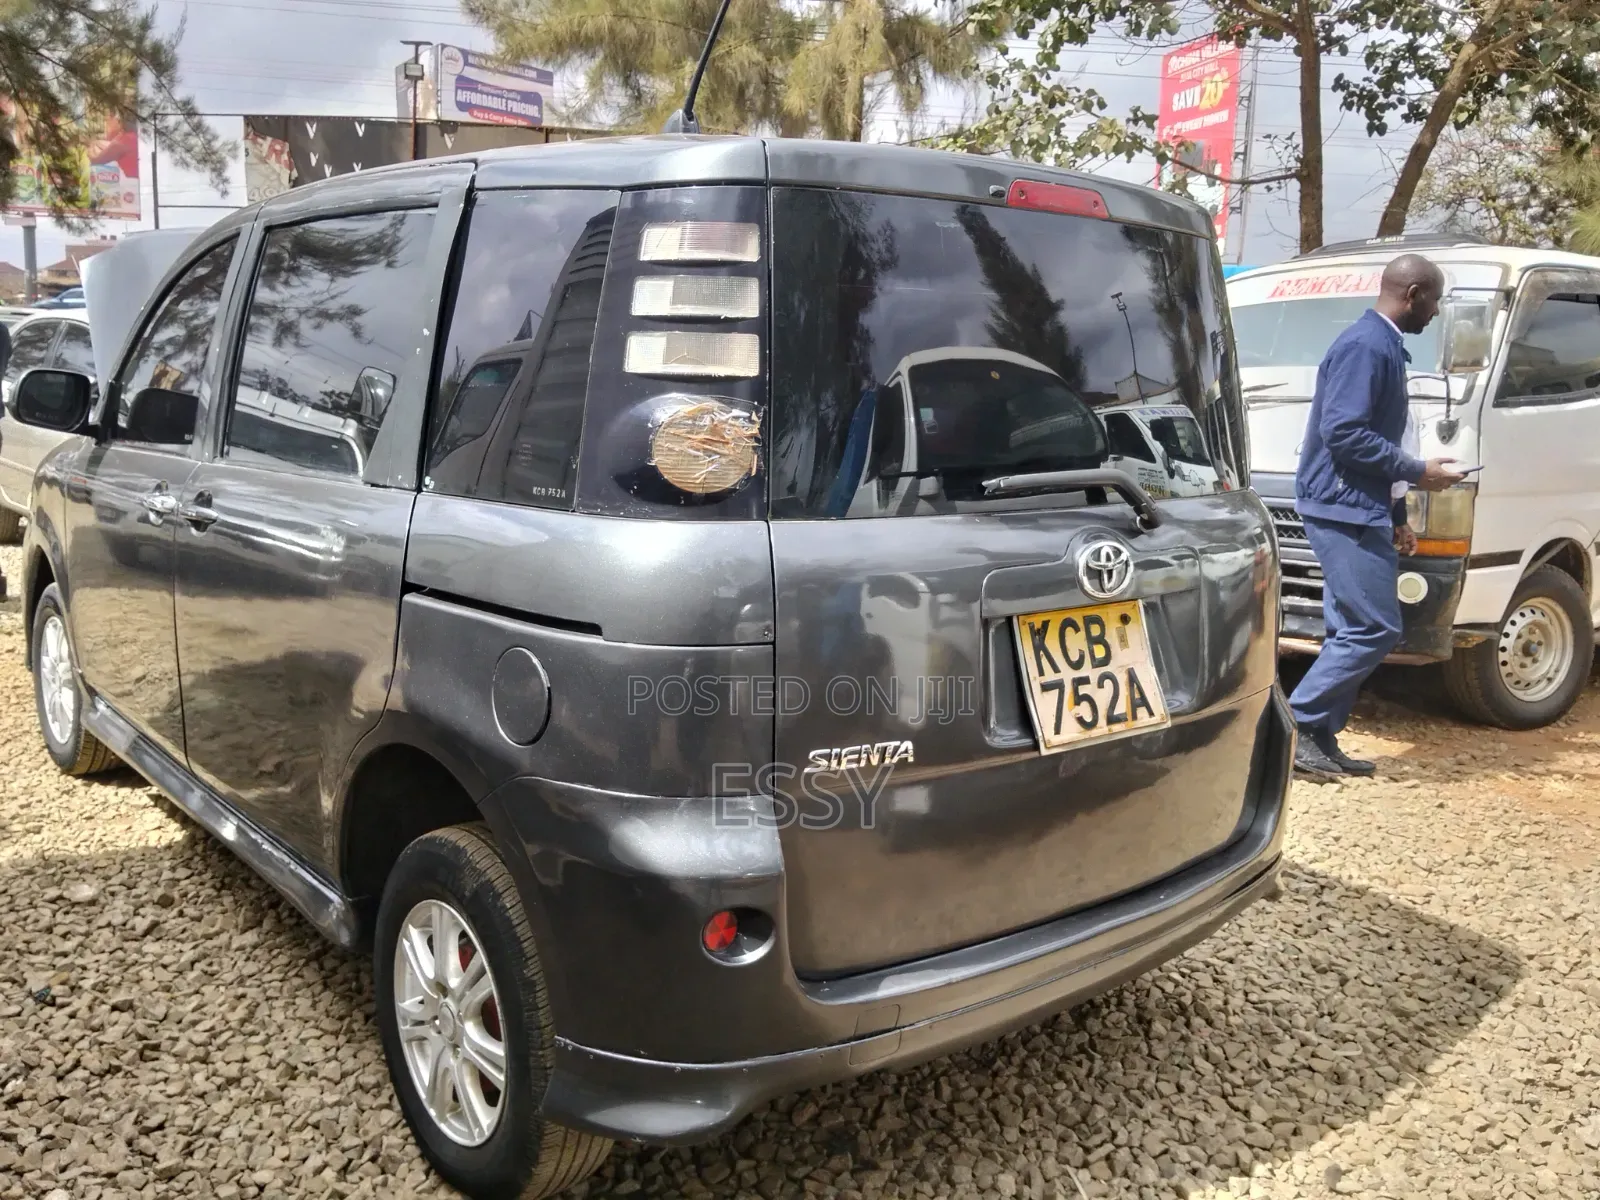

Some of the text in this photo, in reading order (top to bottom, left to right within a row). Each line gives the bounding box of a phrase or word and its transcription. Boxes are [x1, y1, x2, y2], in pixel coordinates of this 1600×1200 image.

[456, 88, 507, 111] AFFORDABLE
[1172, 85, 1201, 112] SAVE
[532, 486, 566, 499] KCB 752A
[1028, 614, 1112, 677] KCB
[1040, 667, 1155, 735] 752A
[803, 740, 914, 773] SIENTA
